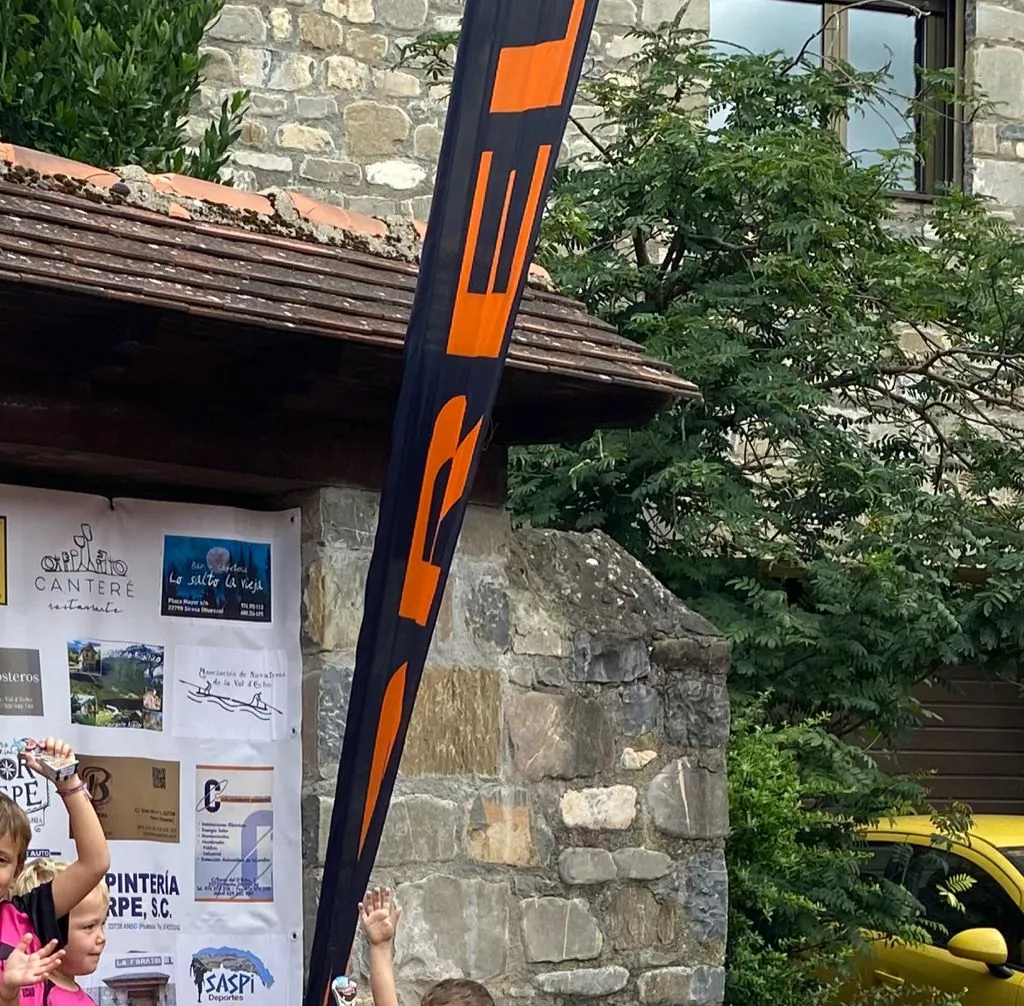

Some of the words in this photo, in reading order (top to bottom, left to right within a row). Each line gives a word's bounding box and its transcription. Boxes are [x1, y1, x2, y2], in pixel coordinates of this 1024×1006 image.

[34, 576, 135, 598] CANTERÉ
[169, 571, 183, 584] Lo
[105, 869, 180, 896] PINTERÍA
[106, 896, 147, 920] RPE,
[151, 898, 172, 919] S.C.
[208, 993, 244, 1002] Deportes
